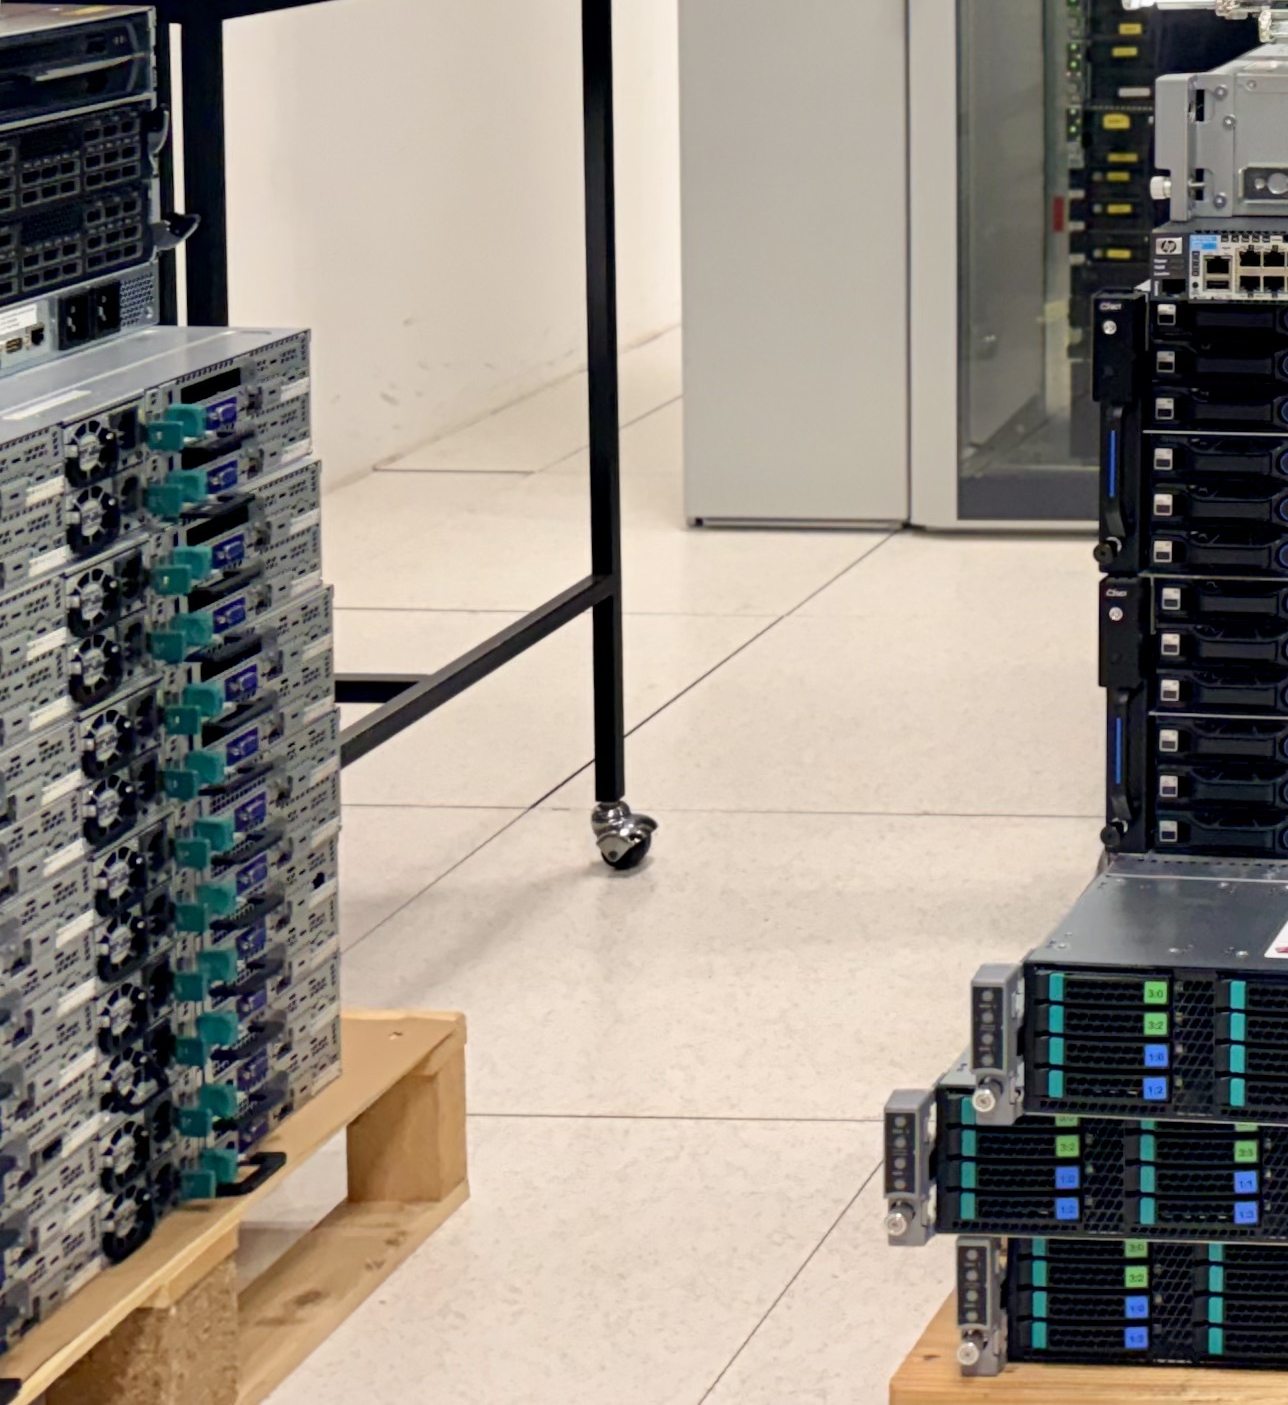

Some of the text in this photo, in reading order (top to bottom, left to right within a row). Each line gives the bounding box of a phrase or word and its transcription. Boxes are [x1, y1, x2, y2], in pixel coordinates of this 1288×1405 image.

[1148, 989, 1164, 999] 3:0
[1147, 1020, 1164, 1030] 3:2
[1149, 1052, 1164, 1062] 1:0
[1148, 1085, 1164, 1095] 1:2
[1060, 1142, 1076, 1152] 3:2
[1239, 1179, 1254, 1188] 1:1
[1129, 1273, 1145, 1283] 3:2
